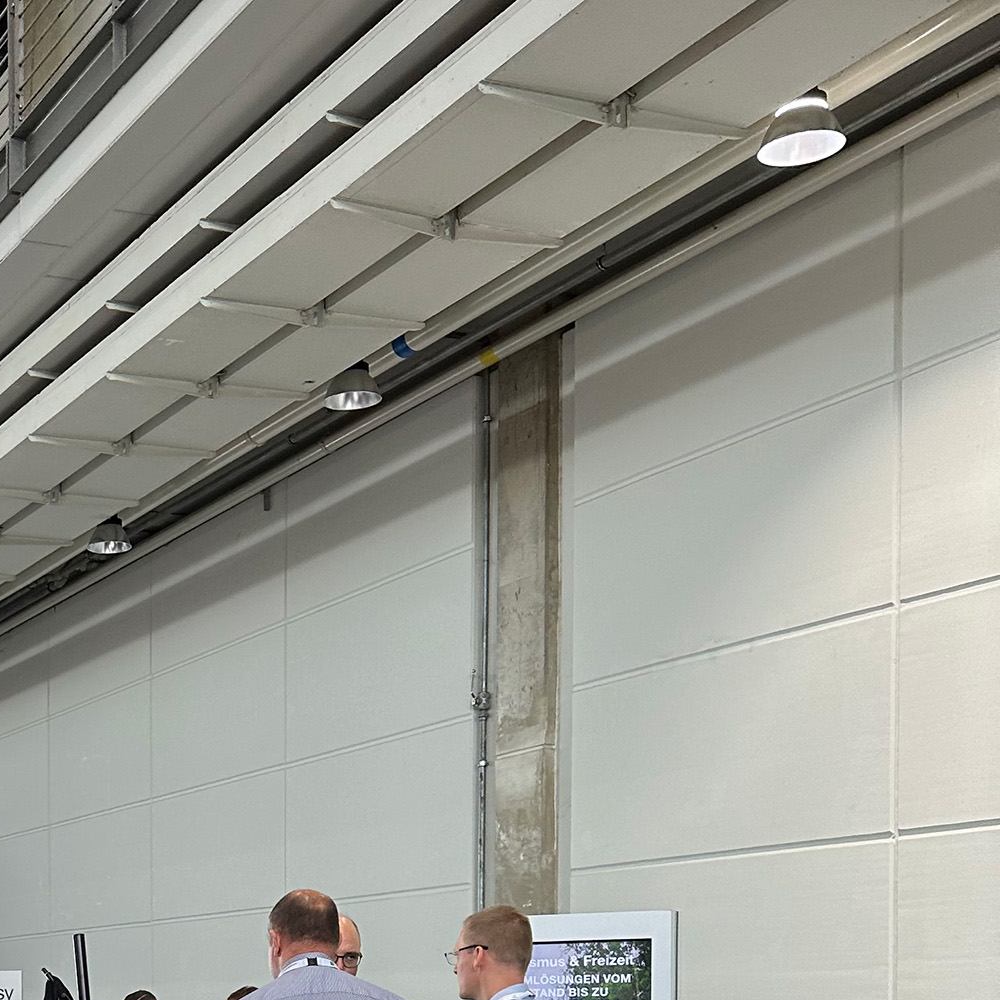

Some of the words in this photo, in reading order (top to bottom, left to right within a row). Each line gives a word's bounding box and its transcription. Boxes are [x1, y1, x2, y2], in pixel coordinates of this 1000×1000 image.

[569, 955, 580, 967] &
[583, 953, 635, 967] Freizeit
[602, 973, 631, 984] VOM
[568, 987, 589, 998] BIS
[591, 987, 609, 998] ZU
